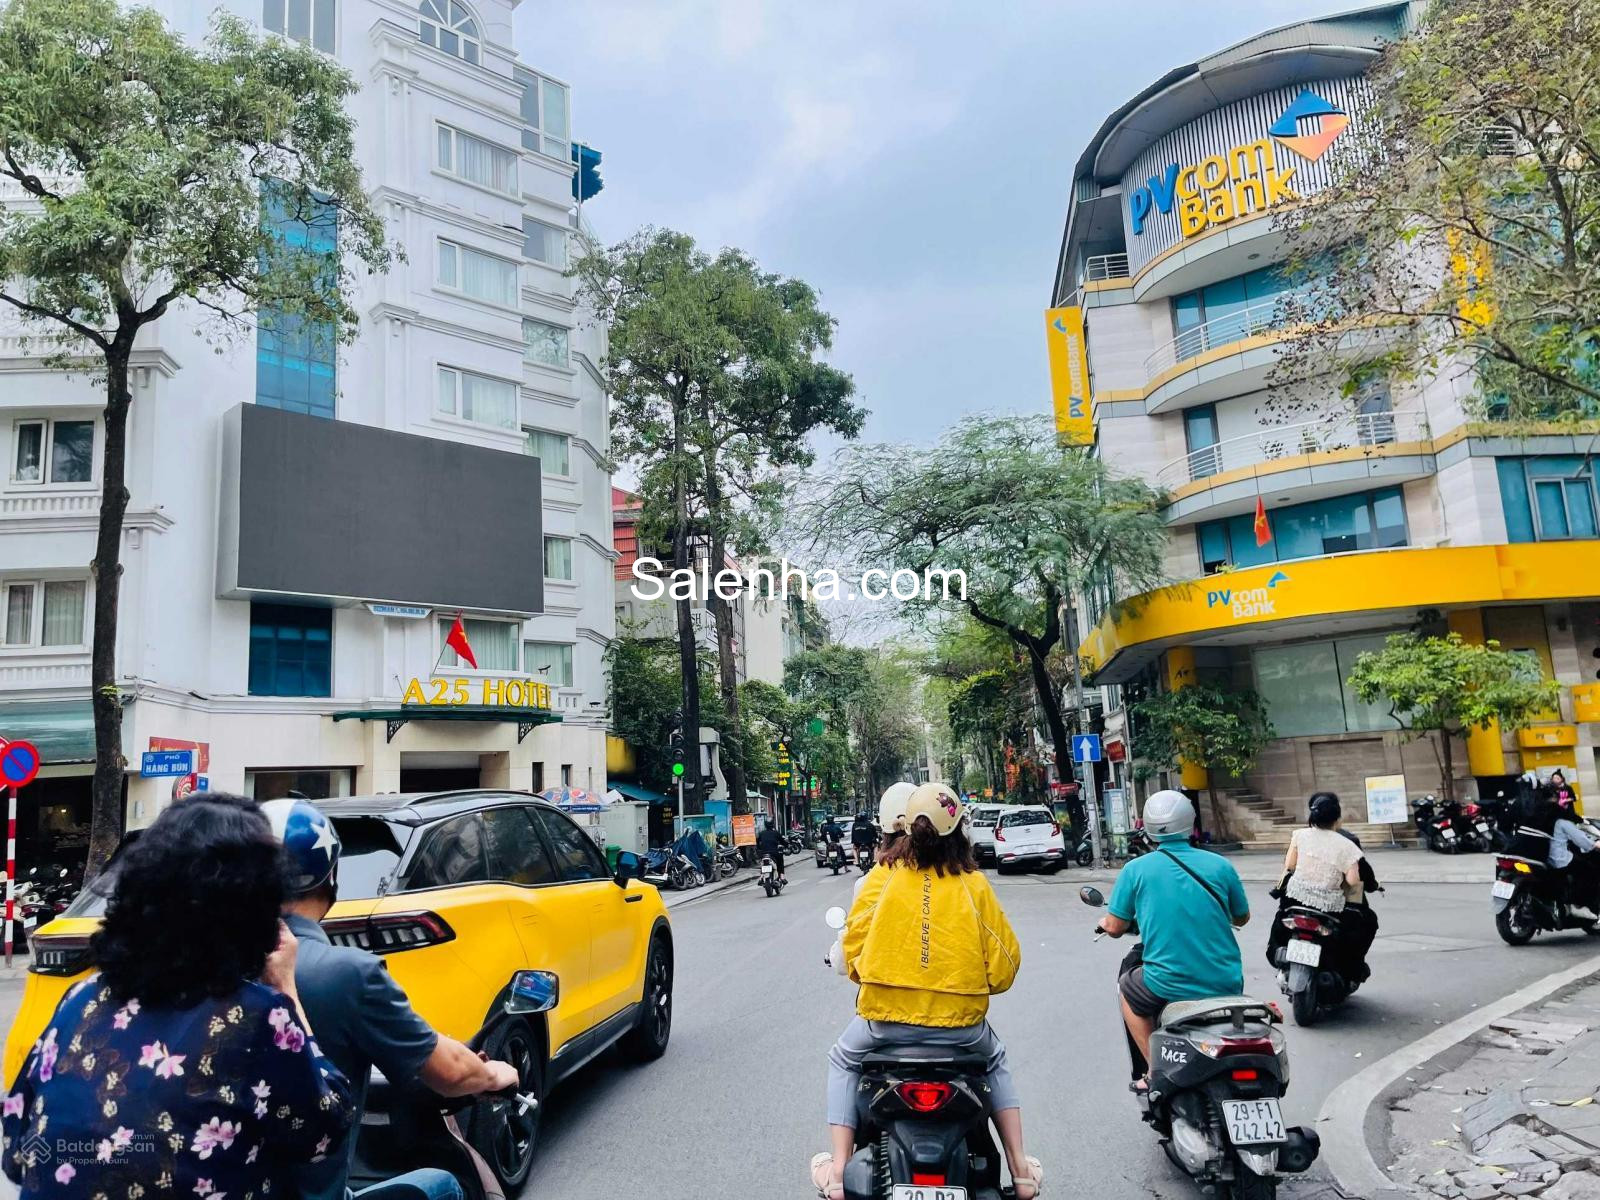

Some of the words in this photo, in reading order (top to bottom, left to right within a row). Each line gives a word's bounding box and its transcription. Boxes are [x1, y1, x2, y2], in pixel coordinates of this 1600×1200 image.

[1180, 167, 1303, 238] Bank
[1232, 599, 1276, 619] Bank
[401, 677, 470, 706] A25
[482, 679, 552, 709] HOTEL
[922, 895, 931, 915] CAN
[920, 922, 930, 964] BELIEVE
[1161, 1046, 1188, 1064] RACE
